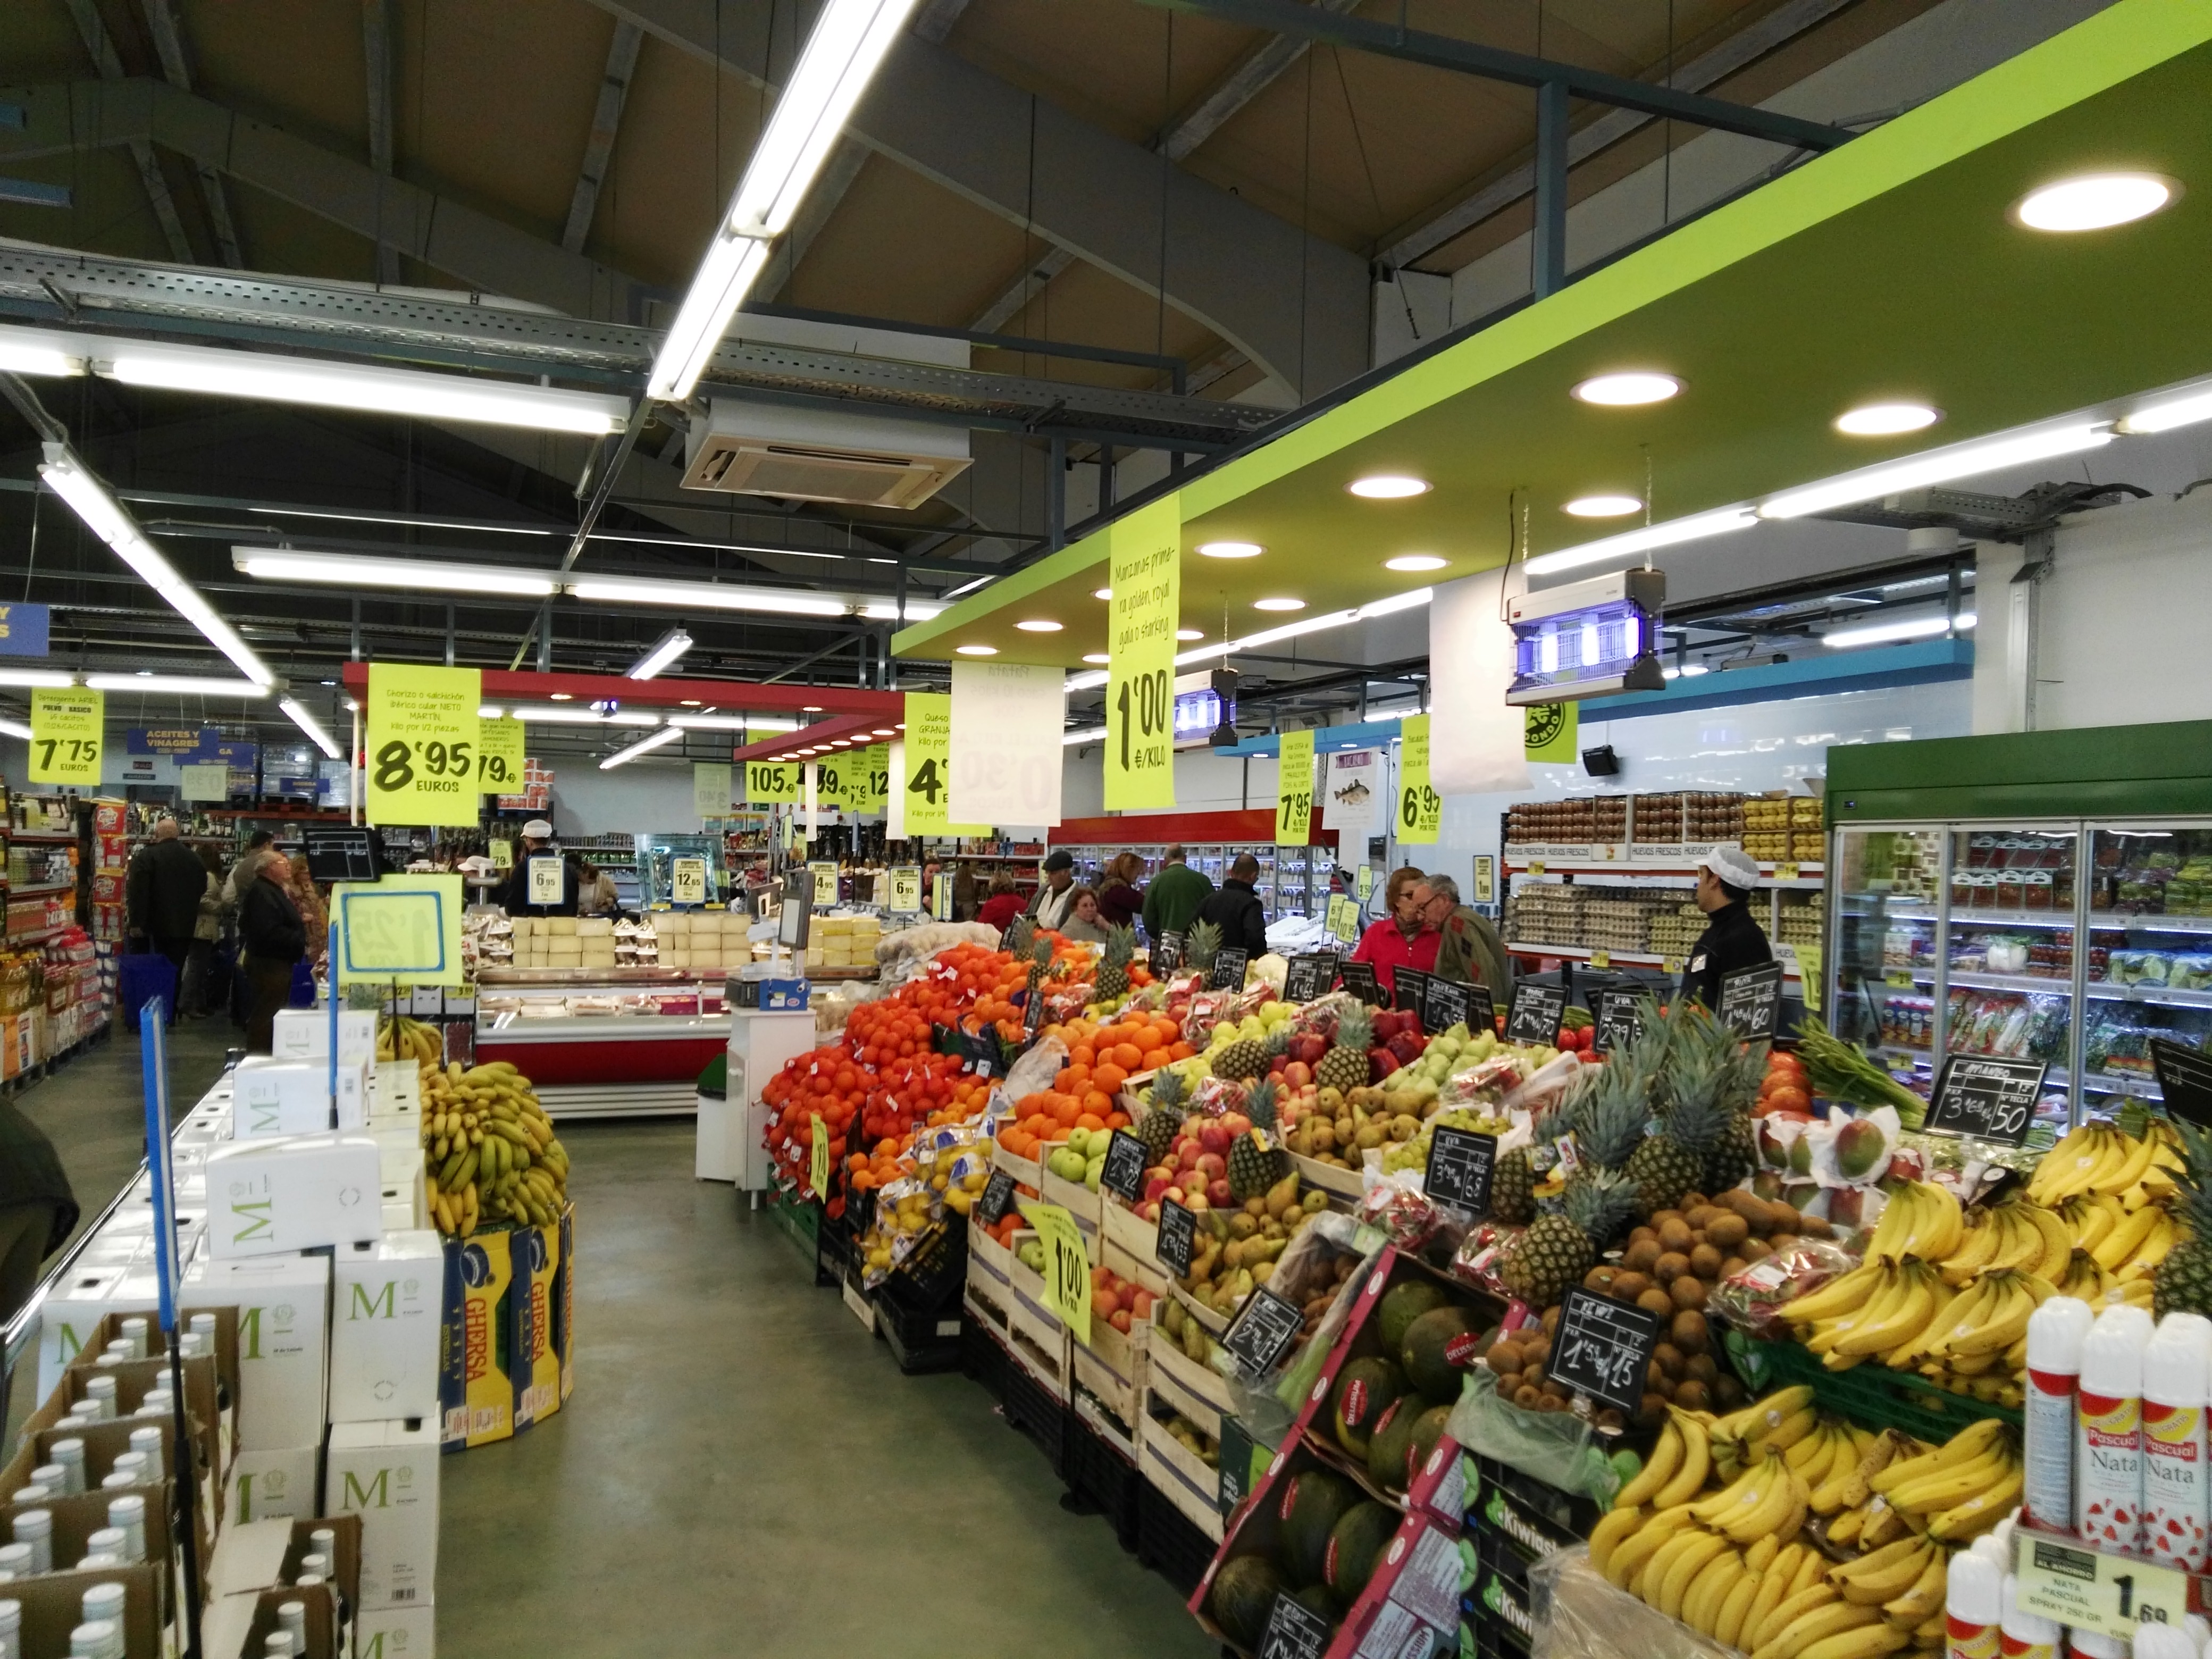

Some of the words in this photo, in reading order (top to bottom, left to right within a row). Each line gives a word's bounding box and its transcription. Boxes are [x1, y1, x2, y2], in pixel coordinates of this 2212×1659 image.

[1115, 556, 1149, 584] Manzanas
[1151, 546, 1175, 577] prime-
[1119, 598, 1127, 614] ra
[1152, 578, 1169, 608] royal
[1119, 626, 1134, 654] gala
[1141, 616, 1169, 641] starking
[387, 690, 416, 698] Chorizo
[406, 724, 419, 733] por
[434, 726, 459, 734] piezas
[919, 725, 950, 734] GRANJA
[925, 713, 948, 722] Queso
[1118, 669, 1167, 772] 1'00
[36, 739, 97, 771] 7'75
[918, 737, 931, 745] kilo
[934, 739, 947, 749] por
[374, 740, 471, 792] 8'95
[416, 781, 458, 792] EUROS
[925, 811, 936, 819] por
[1281, 792, 1310, 831] 7'95
[1614, 996, 1630, 1005] UVA
[1752, 1008, 1770, 1029] 60
[1965, 1063, 2010, 1078] MANGO
[249, 1100, 280, 1134] M
[1991, 1104, 2026, 1133] 50
[1125, 1169, 1139, 1190] 22
[1466, 1175, 1482, 1197] 68
[231, 1198, 274, 1246] M
[347, 1281, 399, 1321] M
[531, 1281, 544, 1363] GHERSA
[466, 1297, 487, 1384] GHERSA
[1611, 1354, 1633, 1388] 15
[1346, 1379, 1361, 1426] DELISSIUM
[2090, 1429, 2138, 1446] Pascual
[2146, 1436, 2194, 1457] Pascual
[2091, 1449, 2138, 1472] Nata
[2146, 1456, 2194, 1483] Nata
[340, 1469, 392, 1510] M
[2052, 1565, 2093, 1579] AHORRO
[2053, 1578, 2081, 1591] NATA
[2042, 1586, 2090, 1606] PASCUAL
[2029, 1596, 2062, 1612] SPRAY
[2087, 1613, 2102, 1623] GR
